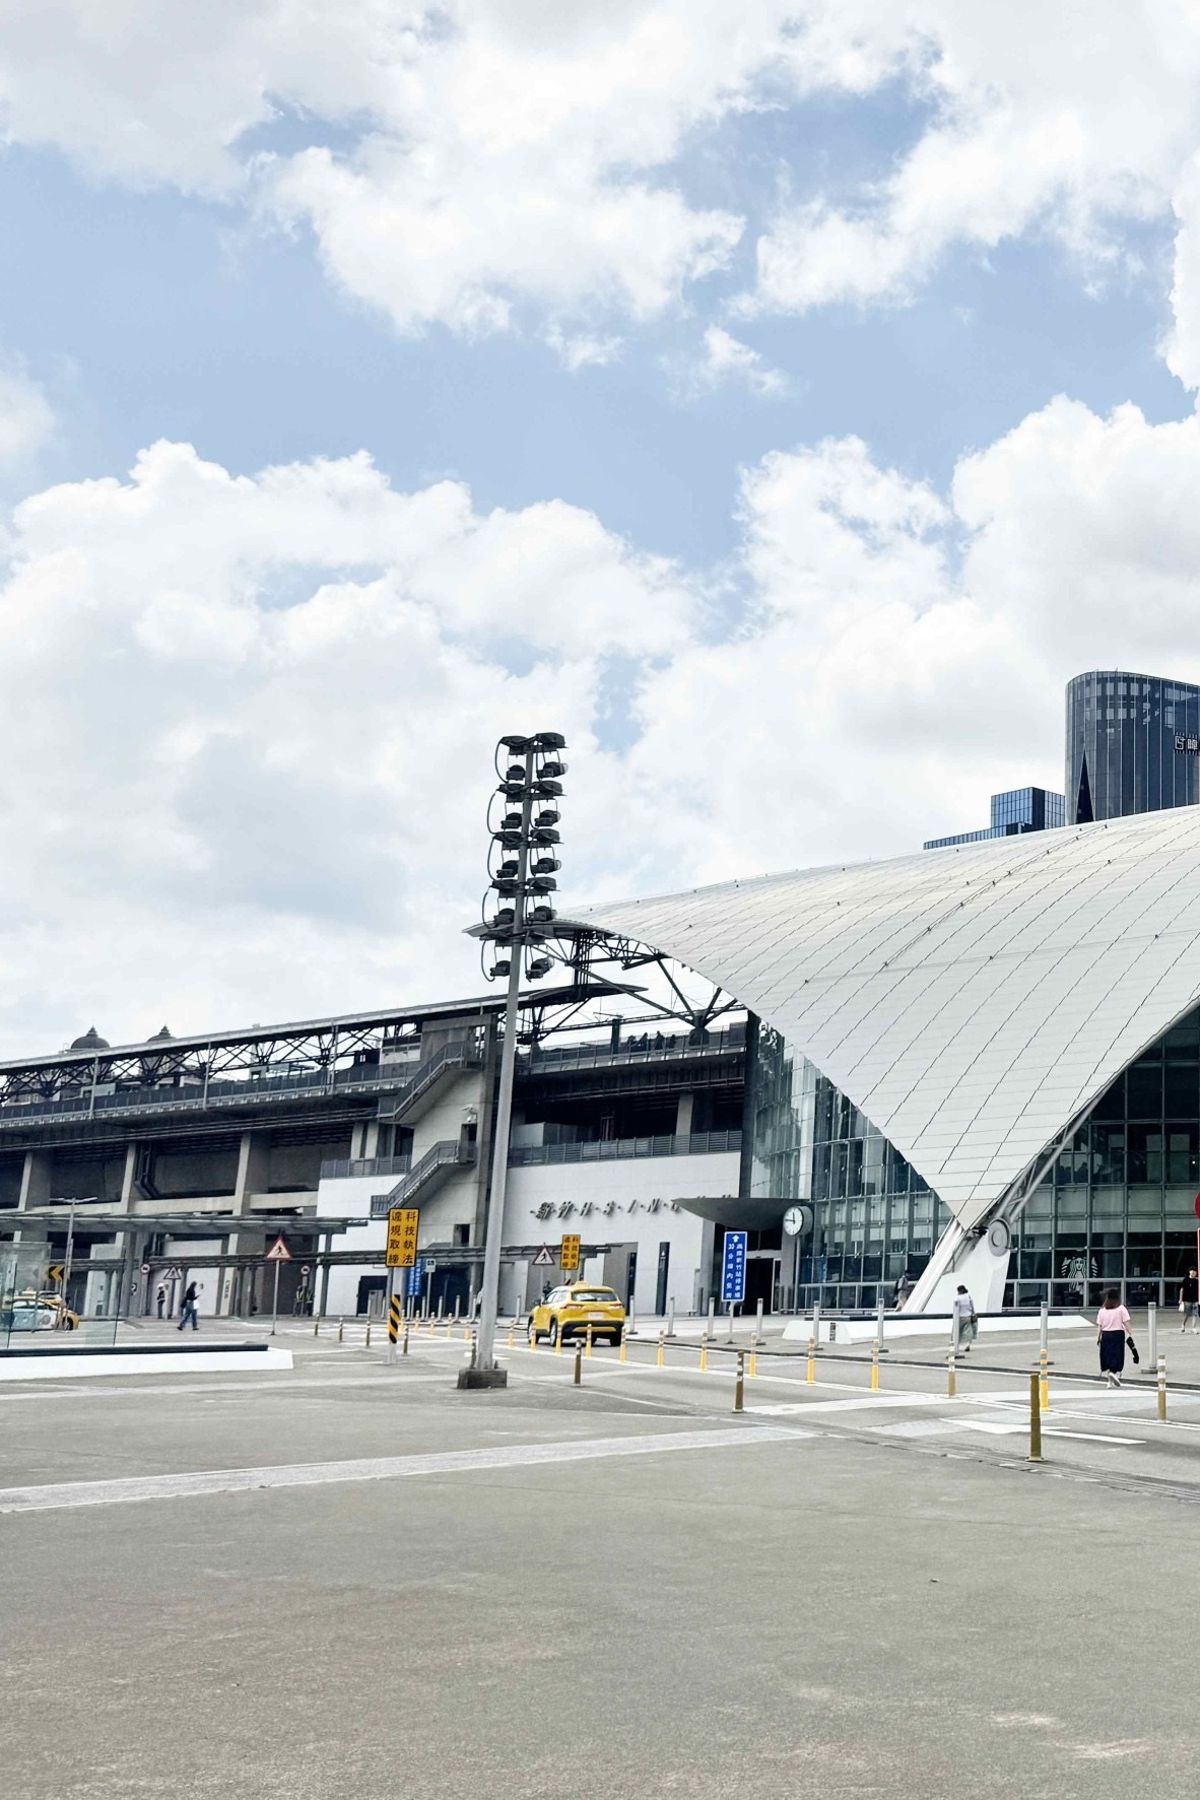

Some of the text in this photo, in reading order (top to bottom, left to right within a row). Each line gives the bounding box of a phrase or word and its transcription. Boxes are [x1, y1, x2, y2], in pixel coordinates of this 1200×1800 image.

[388, 1211, 402, 1264] 違規取締
[402, 1211, 416, 1264] 科技執法
